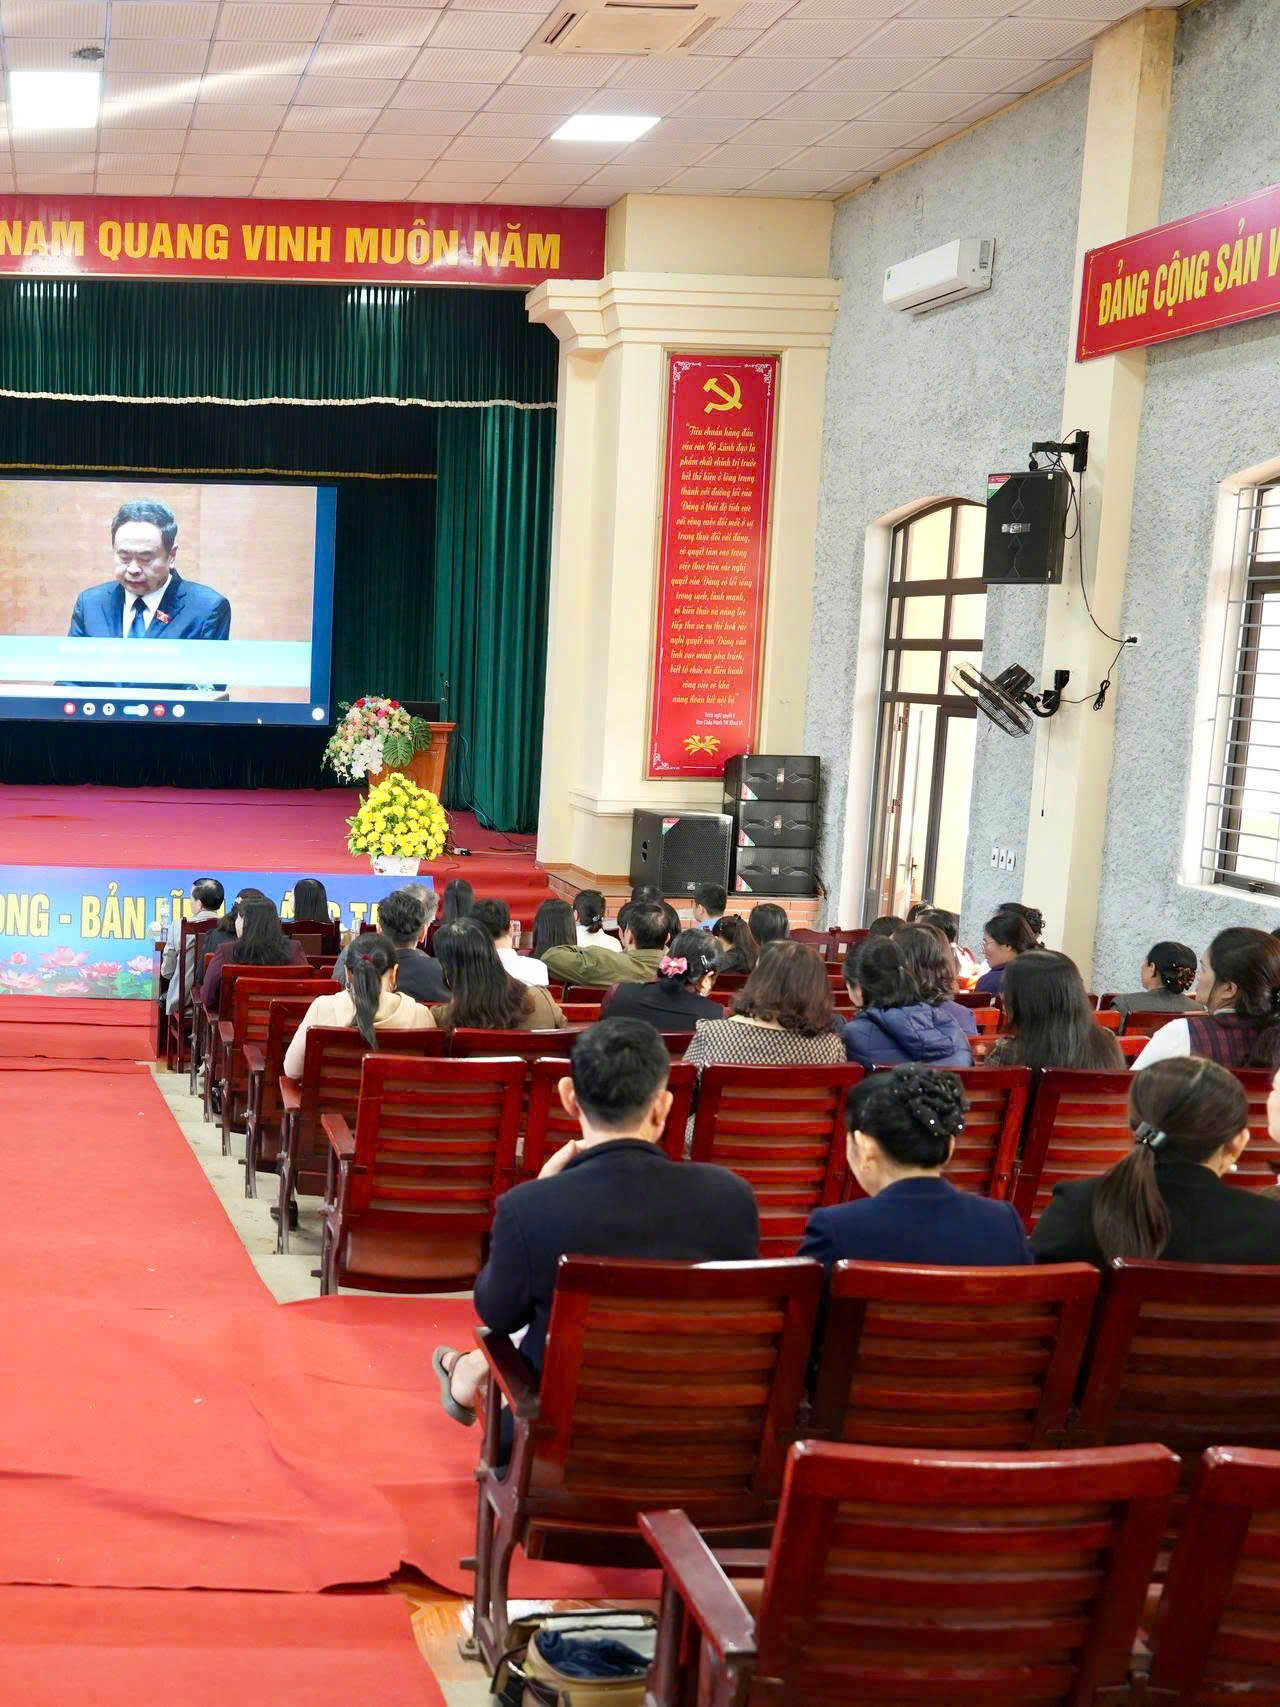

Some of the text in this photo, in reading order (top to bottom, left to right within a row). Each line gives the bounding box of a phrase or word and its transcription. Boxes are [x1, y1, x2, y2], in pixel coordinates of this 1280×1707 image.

[99, 221, 229, 262] QUANG
[242, 224, 330, 263] VINH
[345, 218, 459, 266] MUÔN
[473, 222, 560, 270] NĂM
[1098, 259, 1149, 326] ĐẢNG
[1154, 250, 1209, 317] CỘNG
[1214, 217, 1263, 293] SẢN
[81, 877, 145, 939] BẢN
